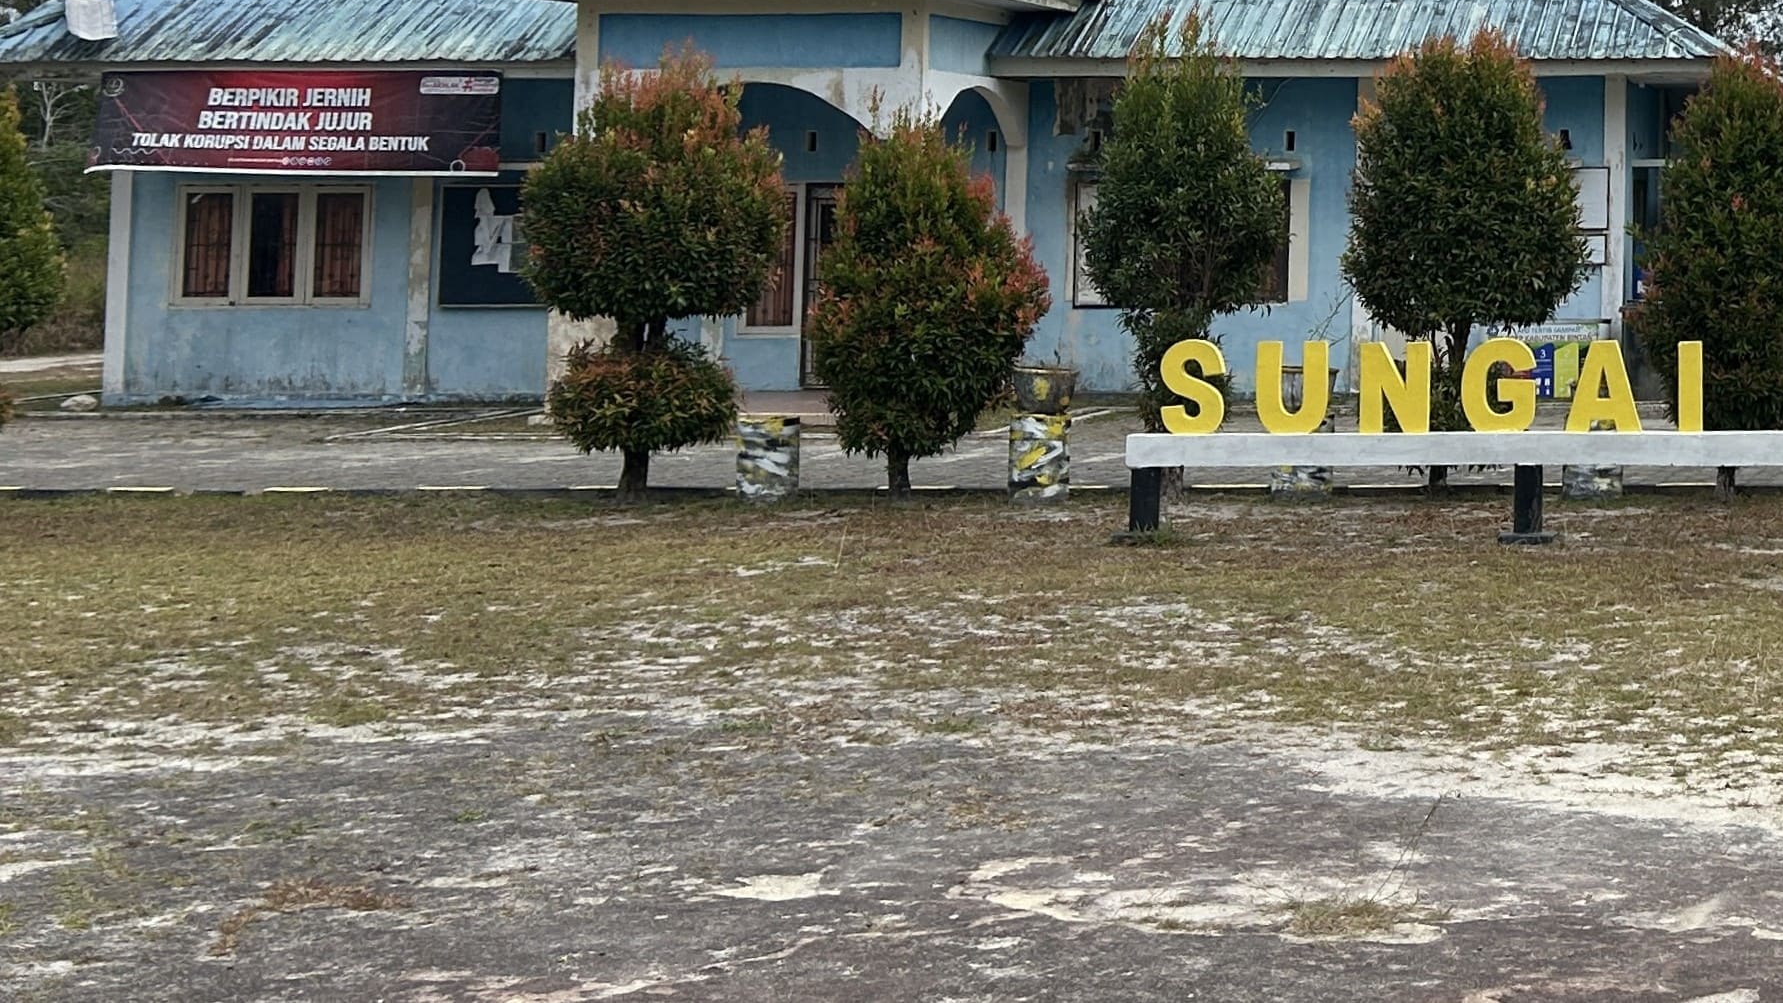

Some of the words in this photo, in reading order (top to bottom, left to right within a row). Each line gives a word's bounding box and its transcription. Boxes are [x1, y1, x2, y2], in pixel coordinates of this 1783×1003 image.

[207, 87, 299, 106] BERPIKIR
[302, 87, 372, 107] JERNIH
[198, 110, 313, 130] BERTINDAK
[314, 111, 373, 131] JUJUR
[131, 132, 183, 148] TOLAK
[183, 134, 251, 150] KORUPSI
[252, 135, 307, 151] DALAM
[308, 136, 365, 152] SEGALA
[368, 136, 430, 152] BENTUK
[1540, 349, 1546, 359] 3
[1160, 338, 1704, 434] SUNGAI
